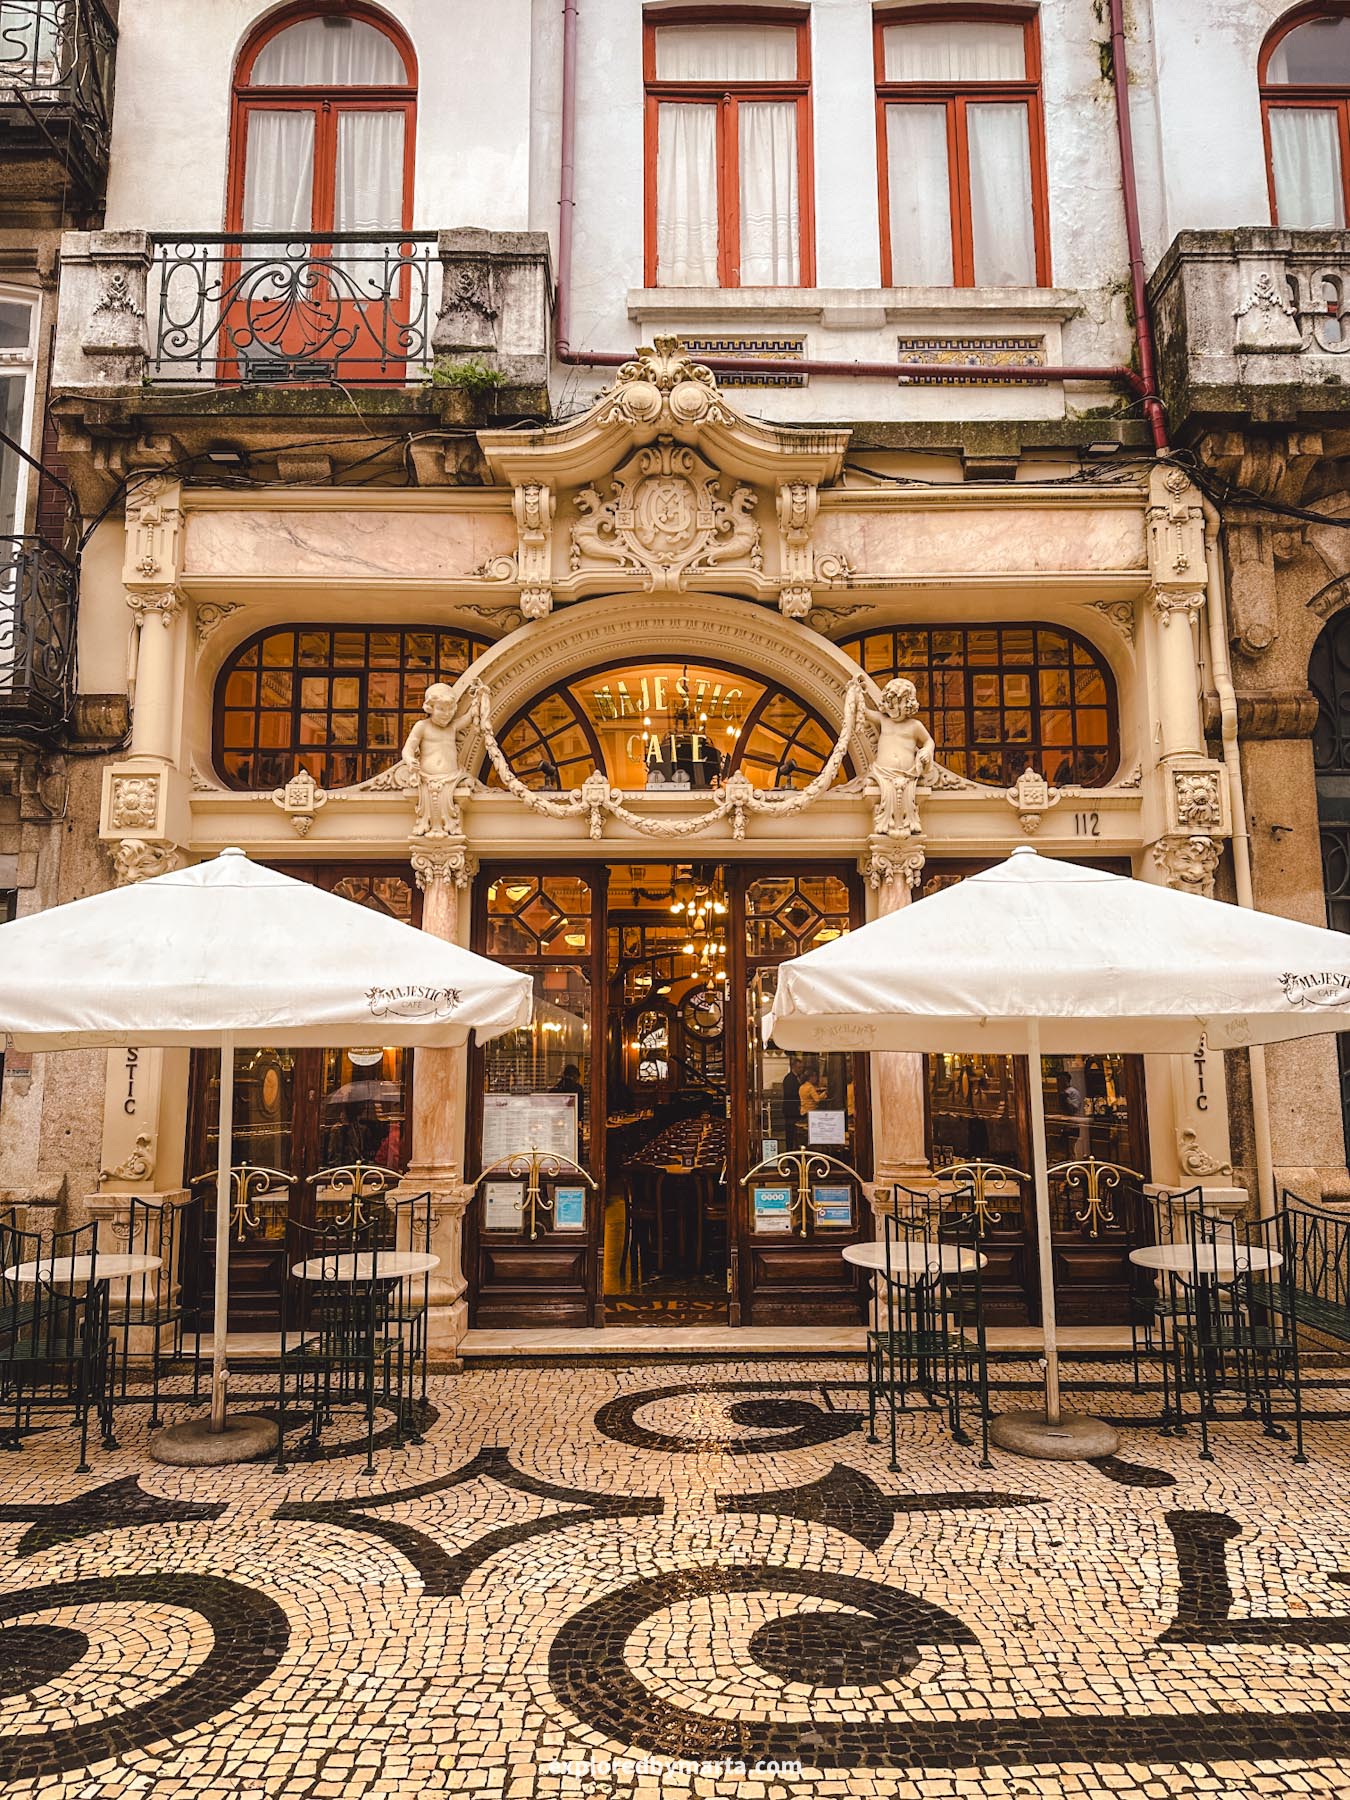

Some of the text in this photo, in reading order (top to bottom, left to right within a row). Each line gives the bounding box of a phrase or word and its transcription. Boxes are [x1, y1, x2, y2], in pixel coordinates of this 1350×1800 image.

[592, 676, 743, 722] MAJESTIC
[1075, 812, 1101, 836] 112
[384, 985, 444, 1003] MAJESTIC
